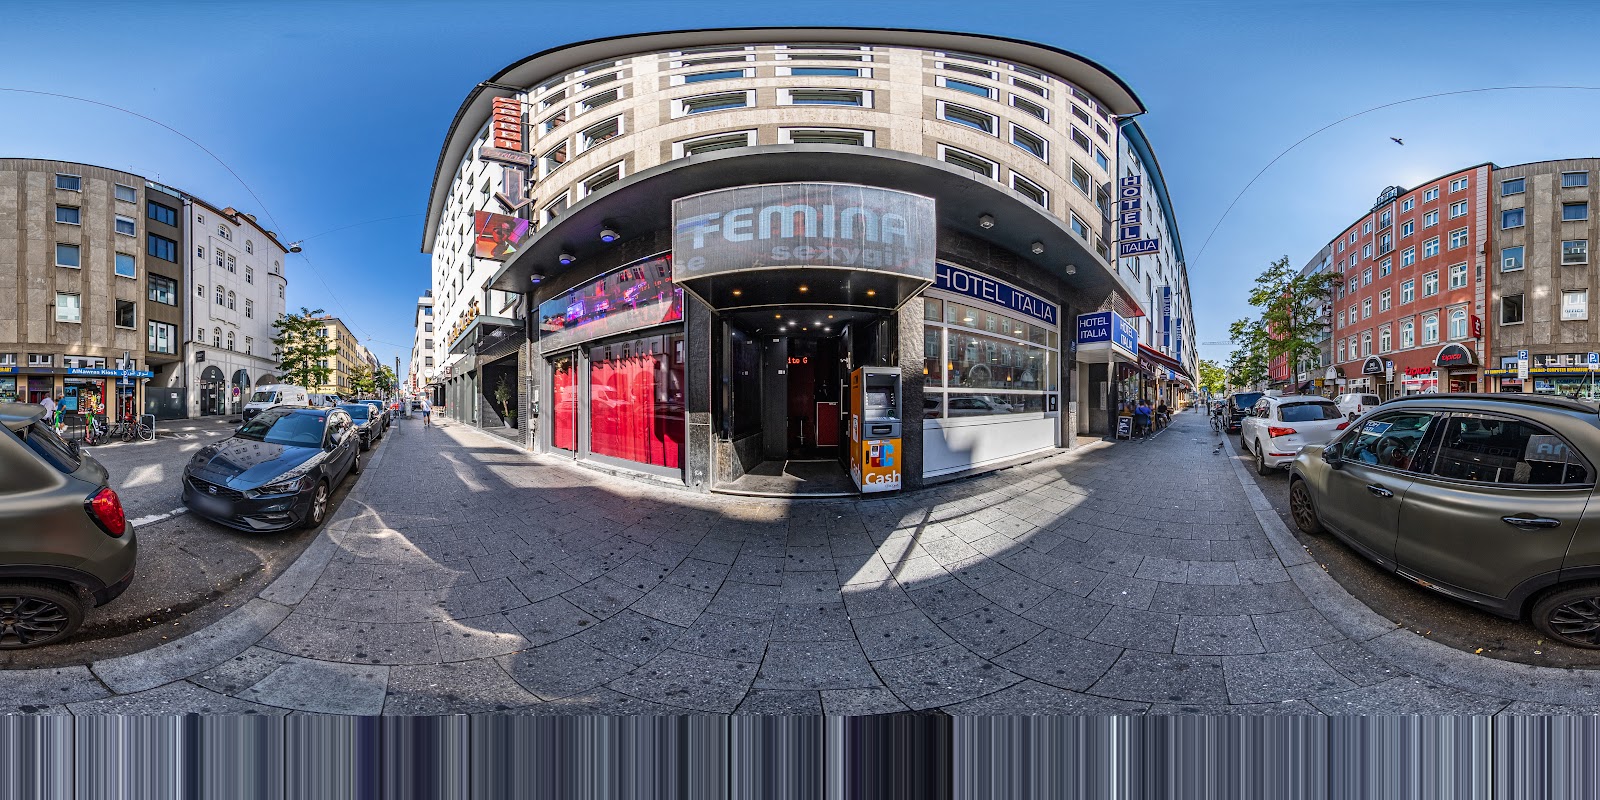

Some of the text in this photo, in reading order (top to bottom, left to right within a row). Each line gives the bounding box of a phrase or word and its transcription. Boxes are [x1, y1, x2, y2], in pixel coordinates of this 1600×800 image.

[499, 98, 518, 149] CABARET
[1123, 176, 1138, 239] HOTEL
[1122, 241, 1156, 253] ITALIA
[934, 268, 1053, 322] HOTEL ITALIA
[1079, 317, 1109, 328] HOTEL
[1080, 328, 1107, 339] ITALIA
[865, 470, 901, 485] Cash
